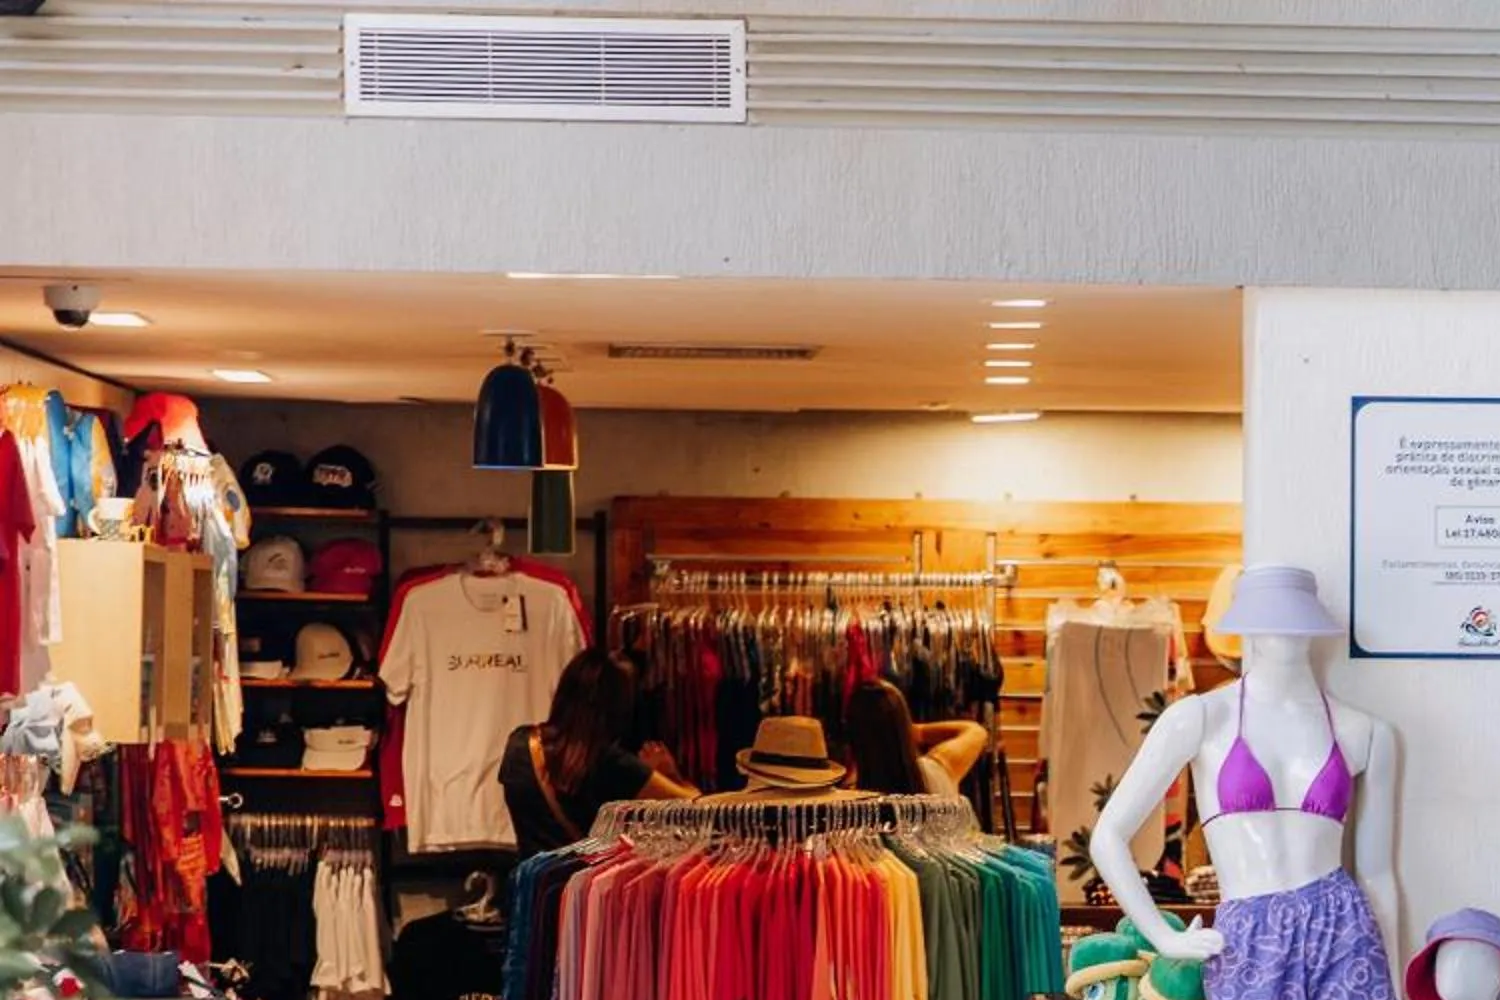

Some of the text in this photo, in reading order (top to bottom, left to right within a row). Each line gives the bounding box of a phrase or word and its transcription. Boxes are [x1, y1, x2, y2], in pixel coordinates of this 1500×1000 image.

[1409, 440, 1500, 452] expressamente
[1395, 450, 1438, 464] prática
[1440, 451, 1455, 463] de
[1385, 464, 1449, 477] orientação
[1452, 464, 1491, 475] sexual
[1449, 476, 1463, 487] de
[1465, 513, 1495, 525] Aviso
[1445, 528, 1461, 539] Lei
